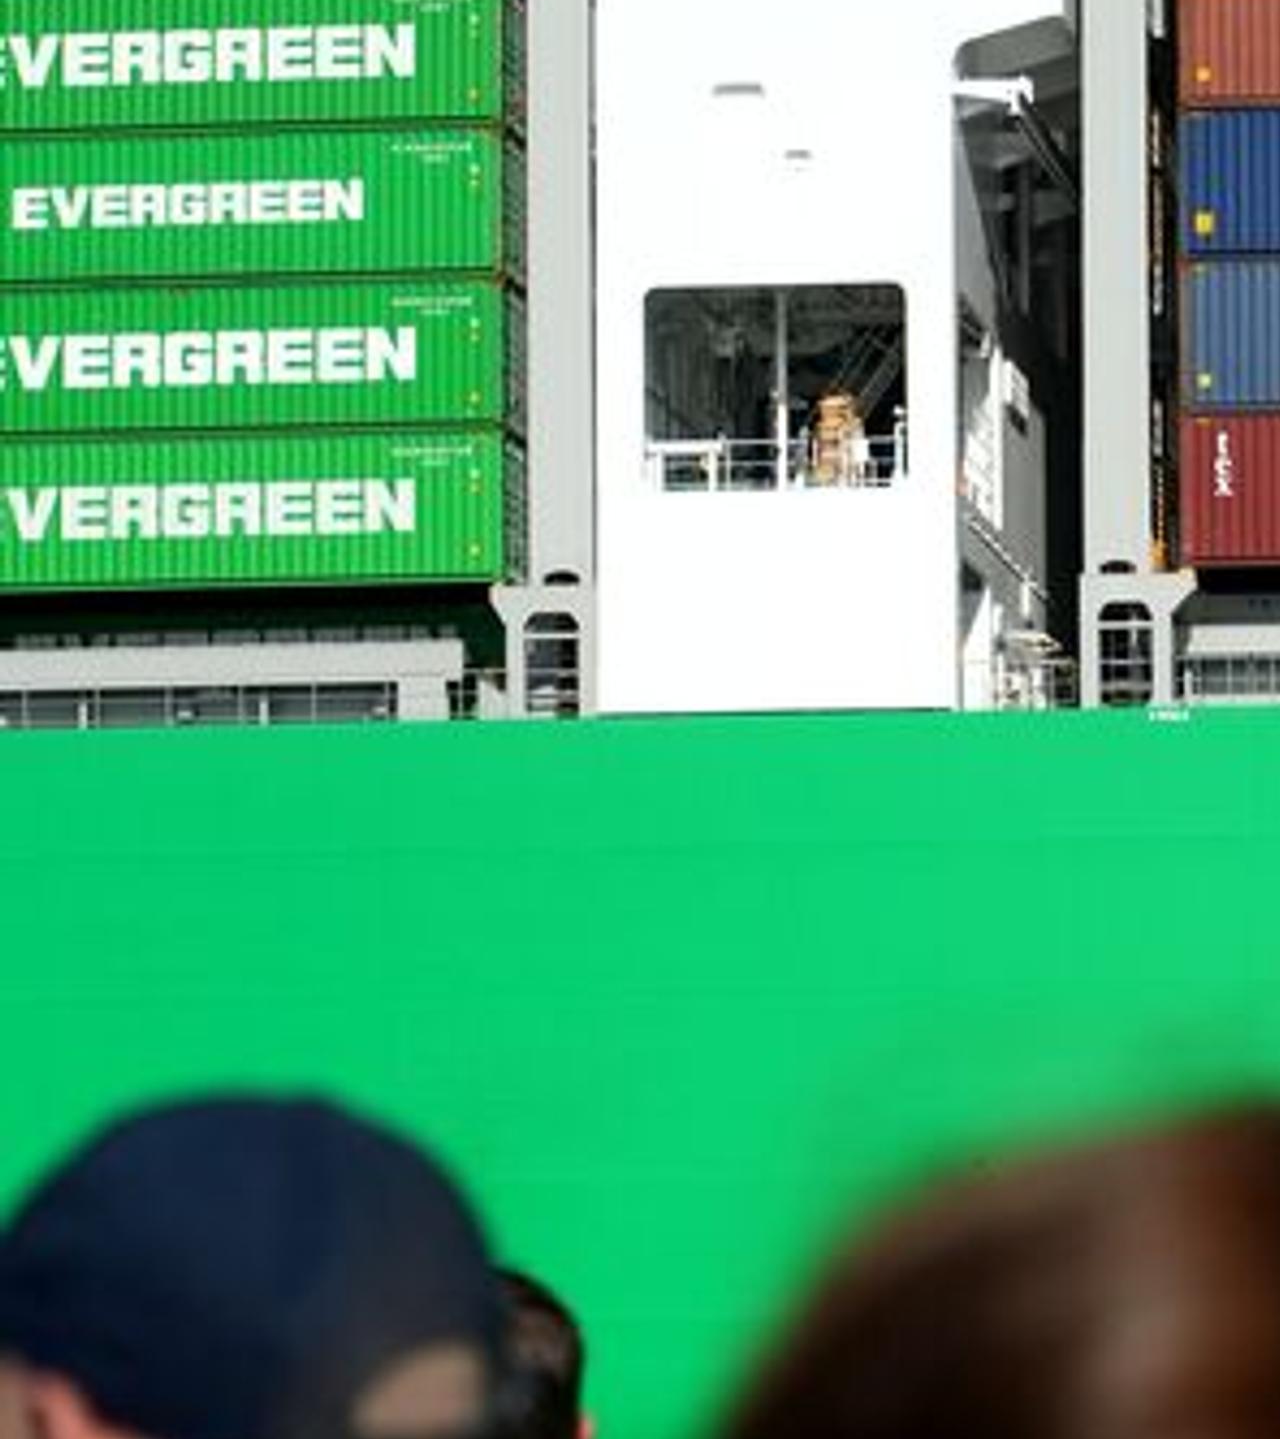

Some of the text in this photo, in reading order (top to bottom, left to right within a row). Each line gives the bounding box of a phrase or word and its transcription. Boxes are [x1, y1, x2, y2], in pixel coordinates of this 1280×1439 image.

[0, 24, 415, 86] VERGREEN
[13, 180, 363, 229] EVERGREEN
[0, 327, 416, 388] VERGREEN
[0, 480, 415, 540] VERGREEN
